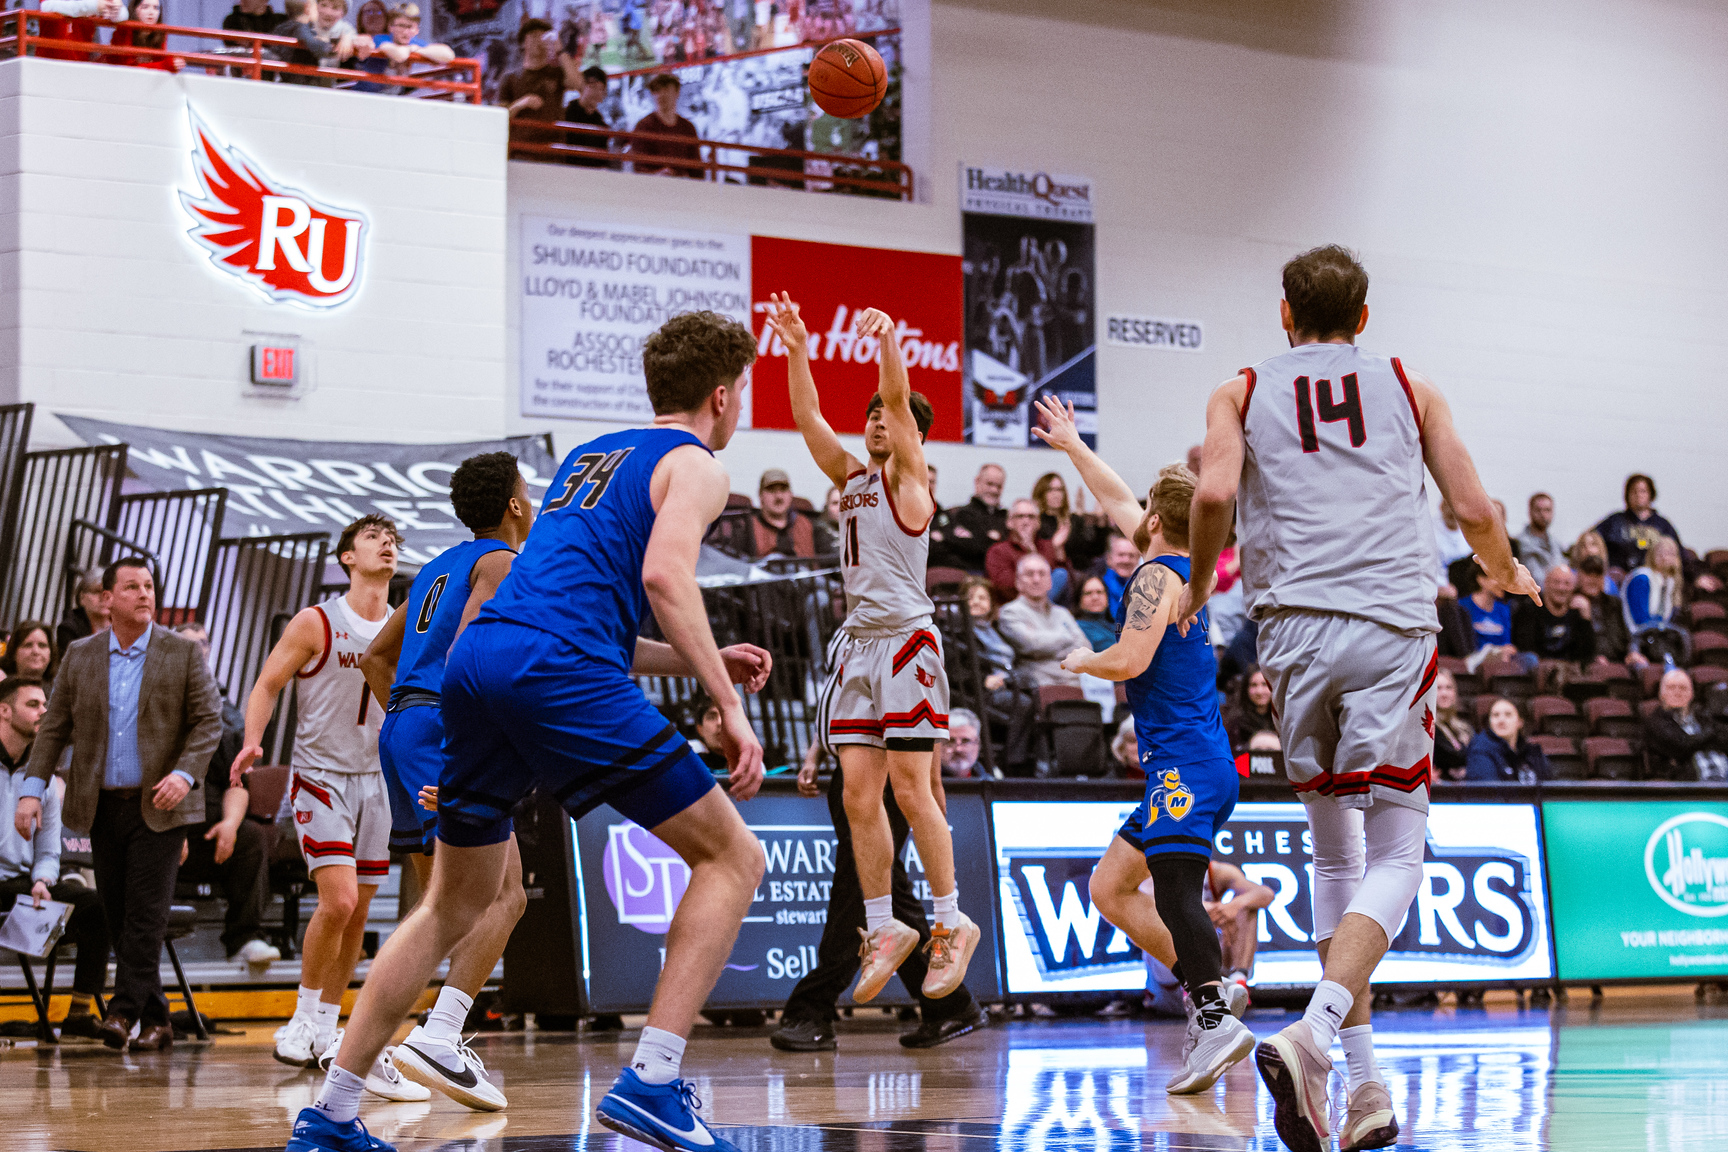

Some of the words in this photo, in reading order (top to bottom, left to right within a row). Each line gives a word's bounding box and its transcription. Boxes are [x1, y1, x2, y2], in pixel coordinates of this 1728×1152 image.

[255, 194, 363, 294] RU
[533, 244, 624, 272] SHUMARD
[625, 253, 741, 281] FOUNDATION
[525, 277, 582, 299] LLOYD
[587, 281, 599, 300] &
[603, 283, 657, 305] MABEL
[664, 287, 748, 312] JOHNSON
[572, 331, 645, 354] ASSOCI
[1107, 318, 1202, 348] RESERVED
[261, 347, 295, 380] EXIT
[1293, 371, 1367, 454] 14
[541, 447, 636, 515] 34
[844, 515, 860, 568] 11
[415, 573, 450, 634] 0
[1169, 796, 1189, 808] M
[760, 840, 839, 874] WAR
[769, 880, 834, 902] ESTAT
[1621, 931, 1657, 947] YOUR
[766, 945, 818, 979] Sell
